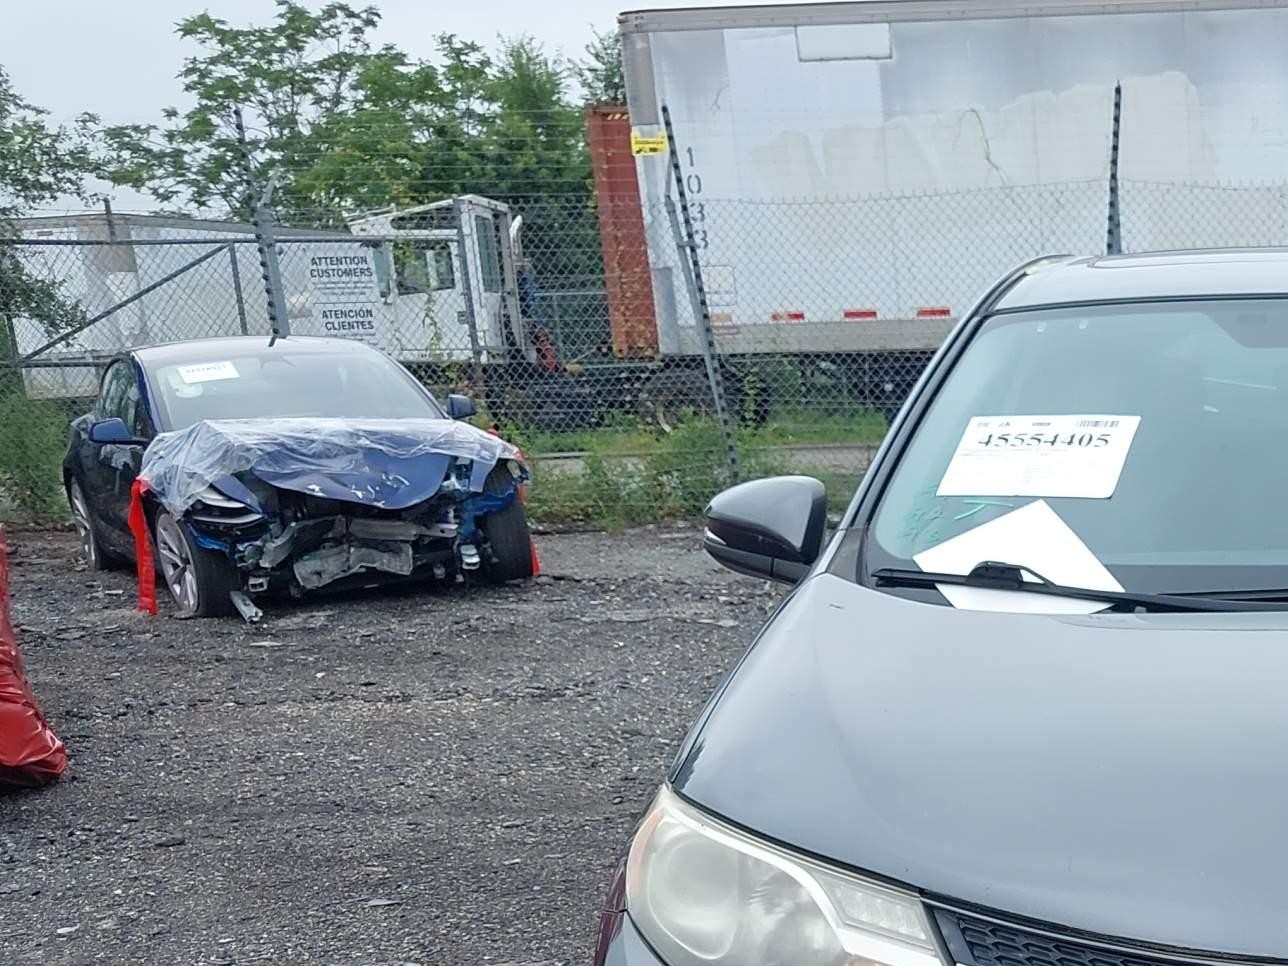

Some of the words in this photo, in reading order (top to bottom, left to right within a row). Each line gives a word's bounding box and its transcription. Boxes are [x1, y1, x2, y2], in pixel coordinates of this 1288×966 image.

[311, 256, 368, 266] ATTENTION
[310, 267, 373, 278] CUSTOMERS
[322, 308, 373, 319] ATENCIÓN
[325, 320, 374, 331] CLIENTES
[977, 432, 1112, 448] 45554405
